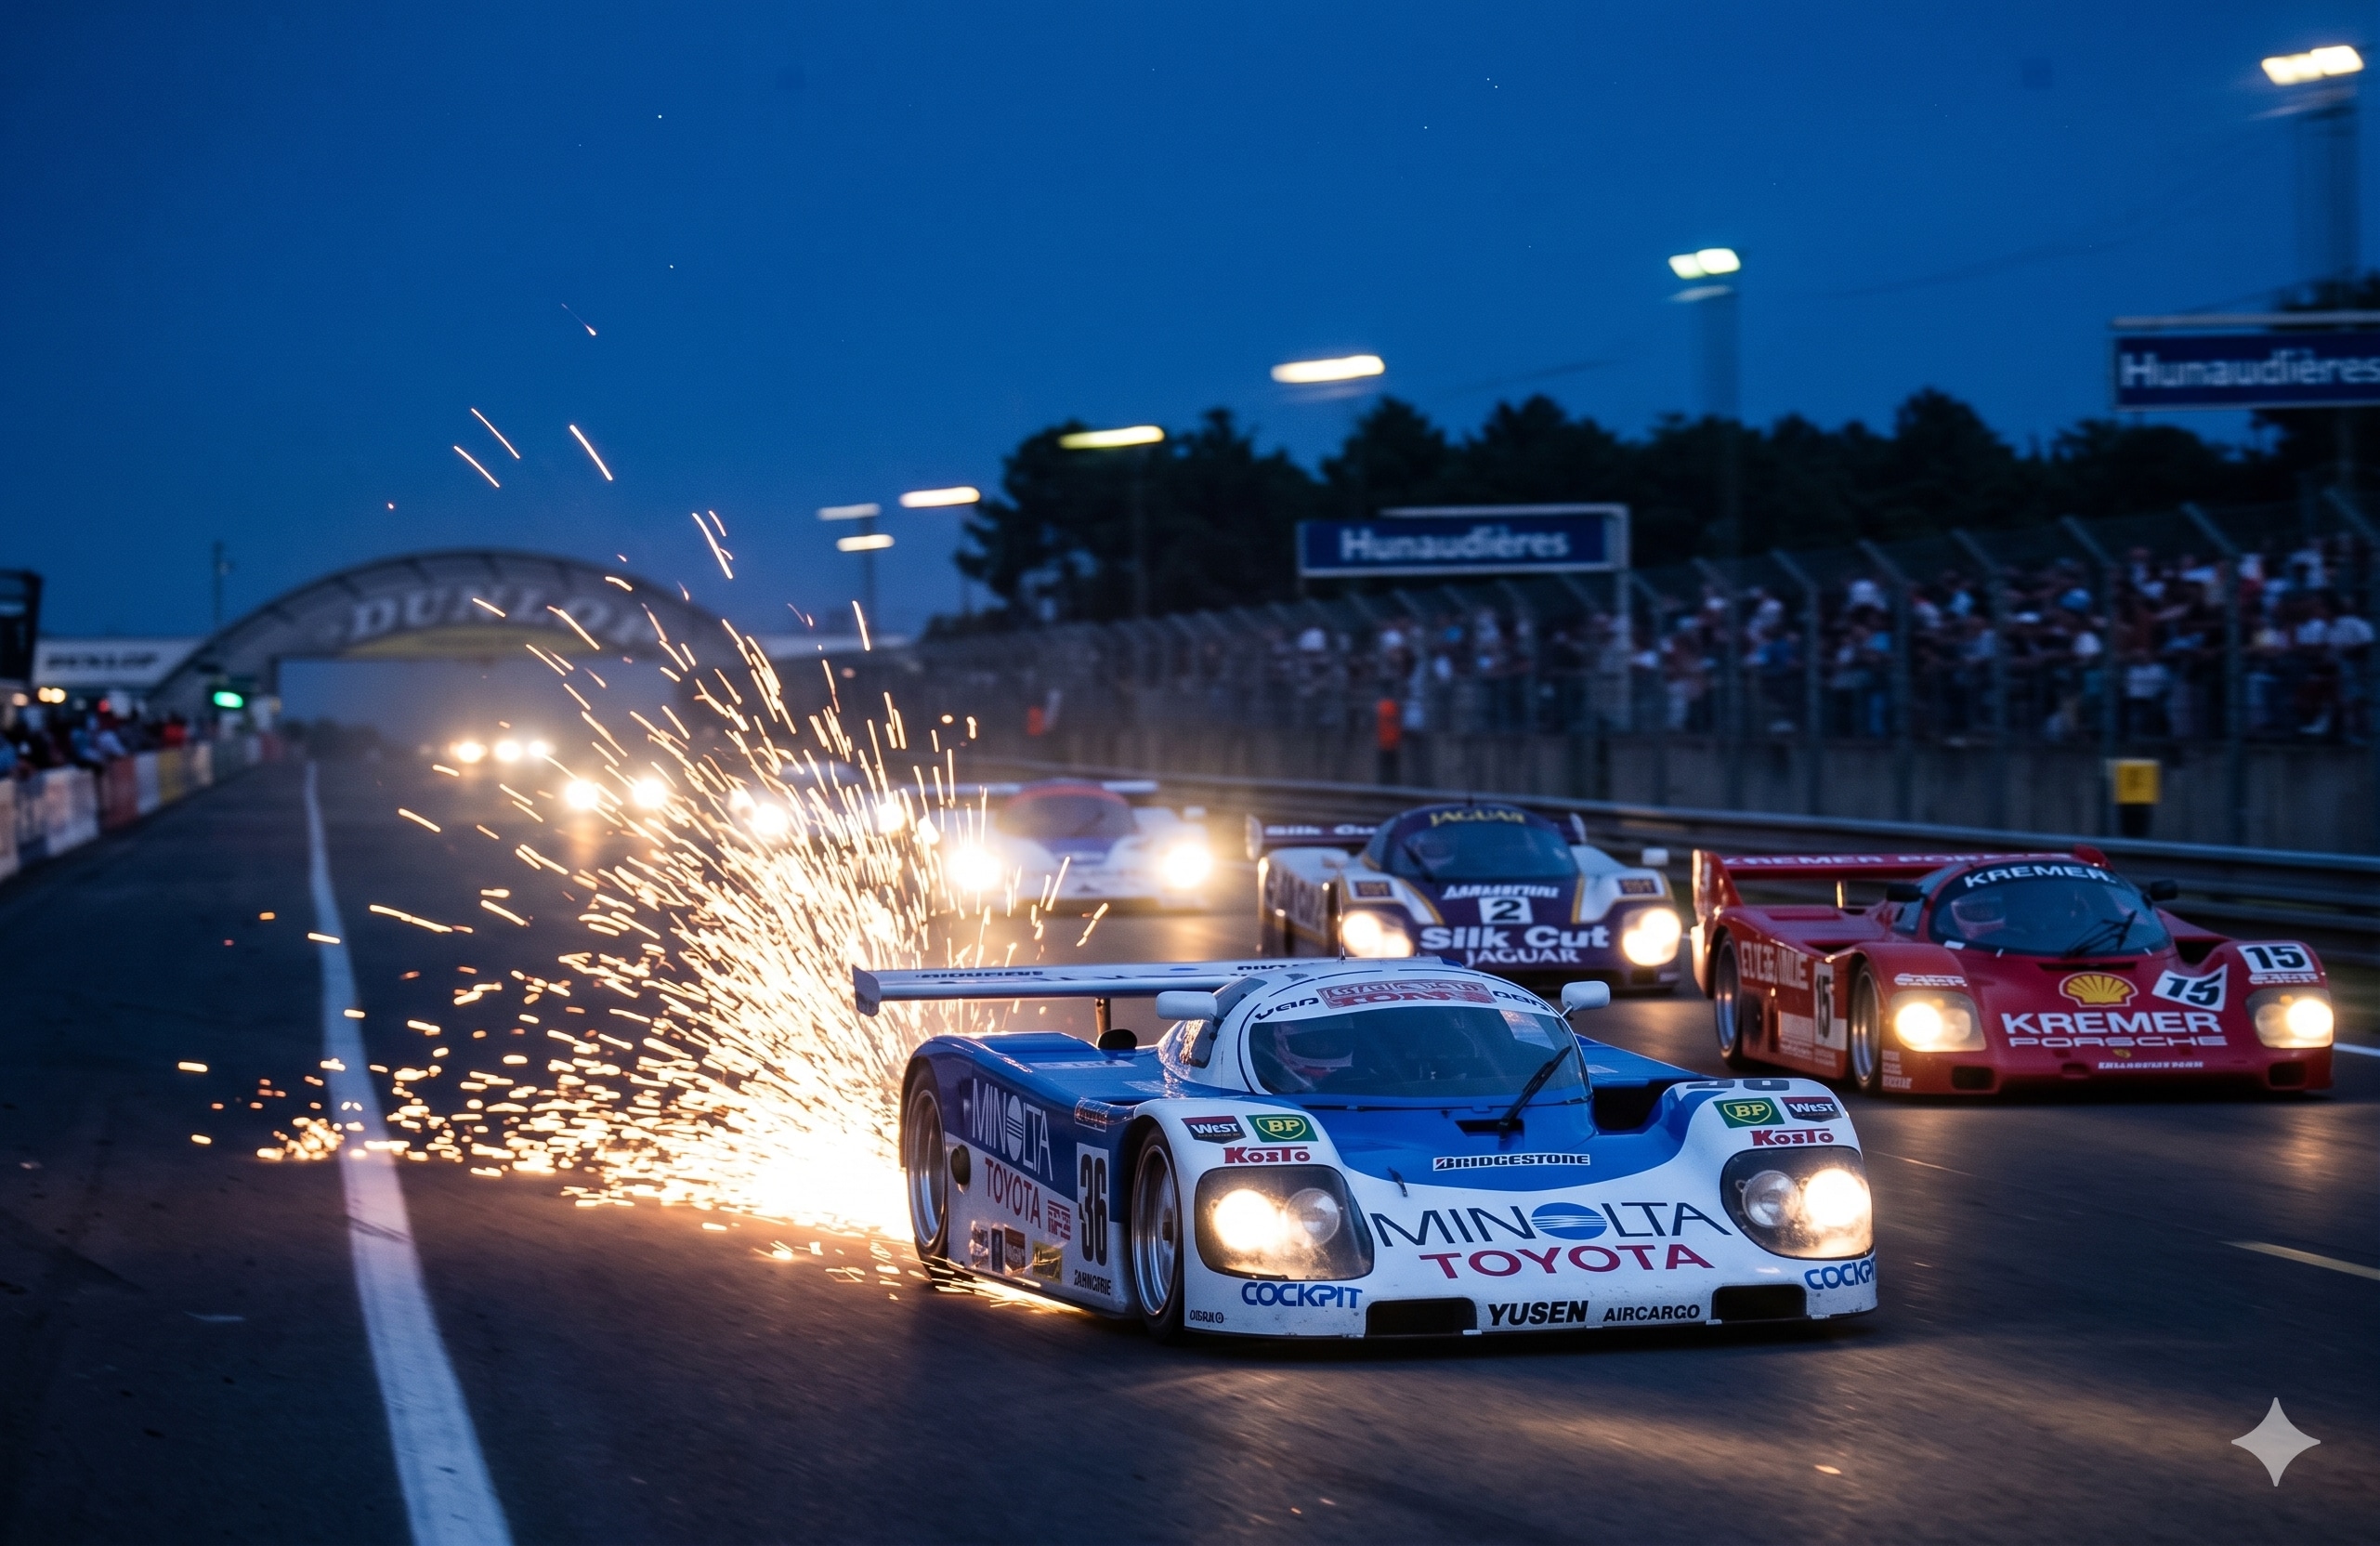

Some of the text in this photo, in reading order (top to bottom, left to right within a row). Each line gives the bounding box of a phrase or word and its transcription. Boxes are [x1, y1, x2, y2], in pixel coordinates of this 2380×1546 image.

[1489, 899, 1522, 921] 2
[1419, 925, 1610, 950] Silk Cut
[1465, 948, 1581, 967] JAGUAR
[2245, 946, 2306, 969] 15
[2166, 974, 2220, 1006] 15
[2000, 1012, 2223, 1034] KREMER
[2008, 1036, 2229, 1048] PORSCHE
[1733, 1105, 1766, 1118] BP
[973, 1078, 1053, 1182] MINOLTA
[1267, 1120, 1301, 1133] BP
[1435, 1154, 1590, 1170] BRIDGESTONE
[985, 1158, 1041, 1229] TOYOTA
[1079, 1154, 1107, 1266] 36
[1369, 1202, 1733, 1248] MINOLTA
[1419, 1243, 1716, 1279] TOYOTA
[1242, 1281, 1363, 1309] COCKPIT
[1487, 1301, 1700, 1326] YUSEN AIRCARGO
